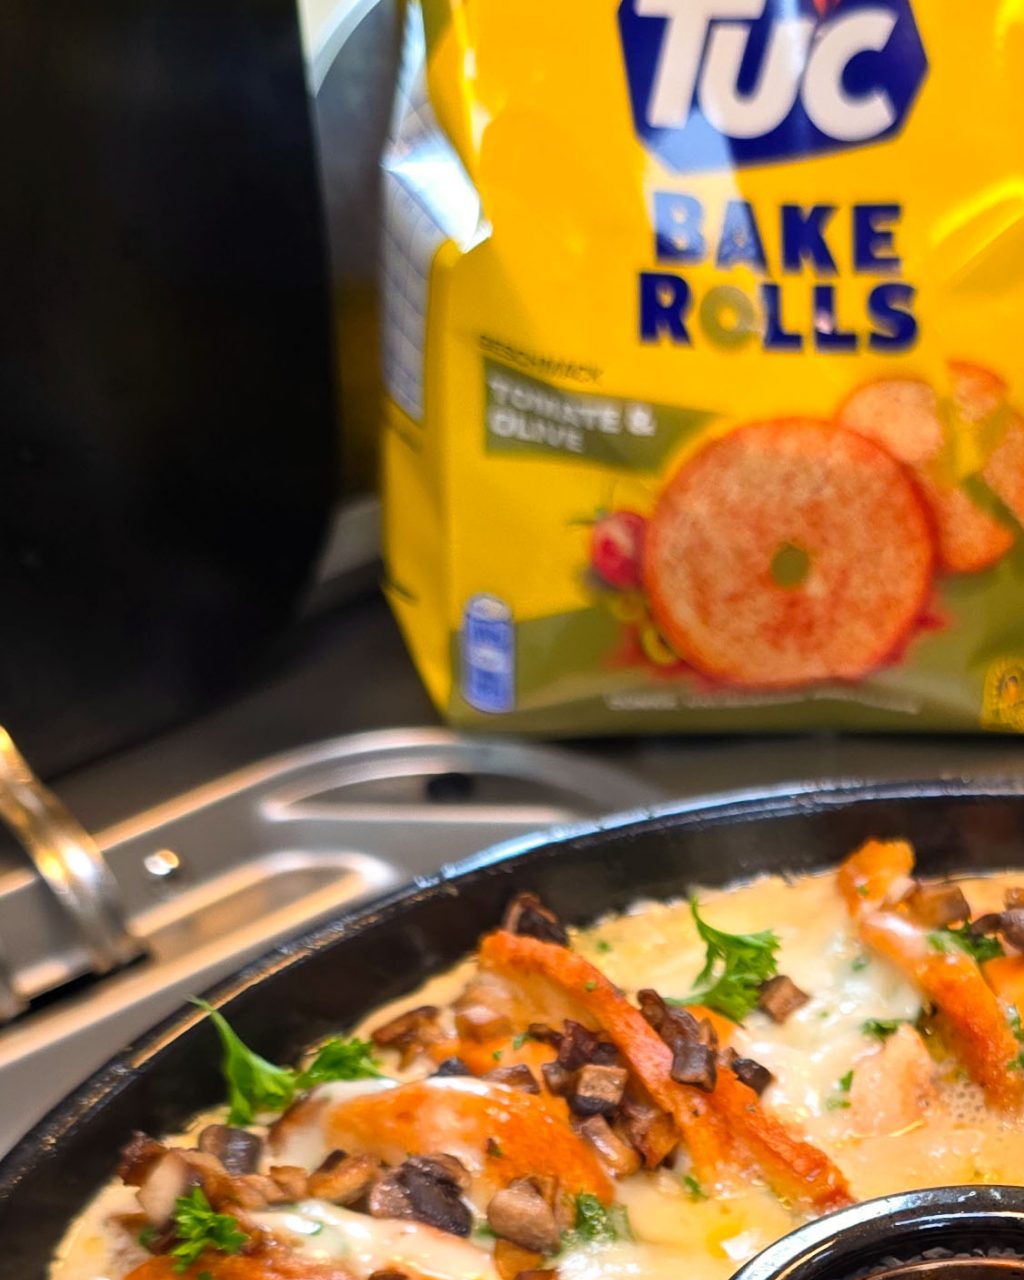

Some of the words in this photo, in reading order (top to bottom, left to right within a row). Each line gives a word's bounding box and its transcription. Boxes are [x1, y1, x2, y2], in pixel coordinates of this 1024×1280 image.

[637, 0, 899, 142] TUC
[653, 190, 903, 275] BAKE
[639, 271, 917, 353] ROLLS
[489, 411, 583, 453] OLIVE
[625, 402, 657, 437] &
